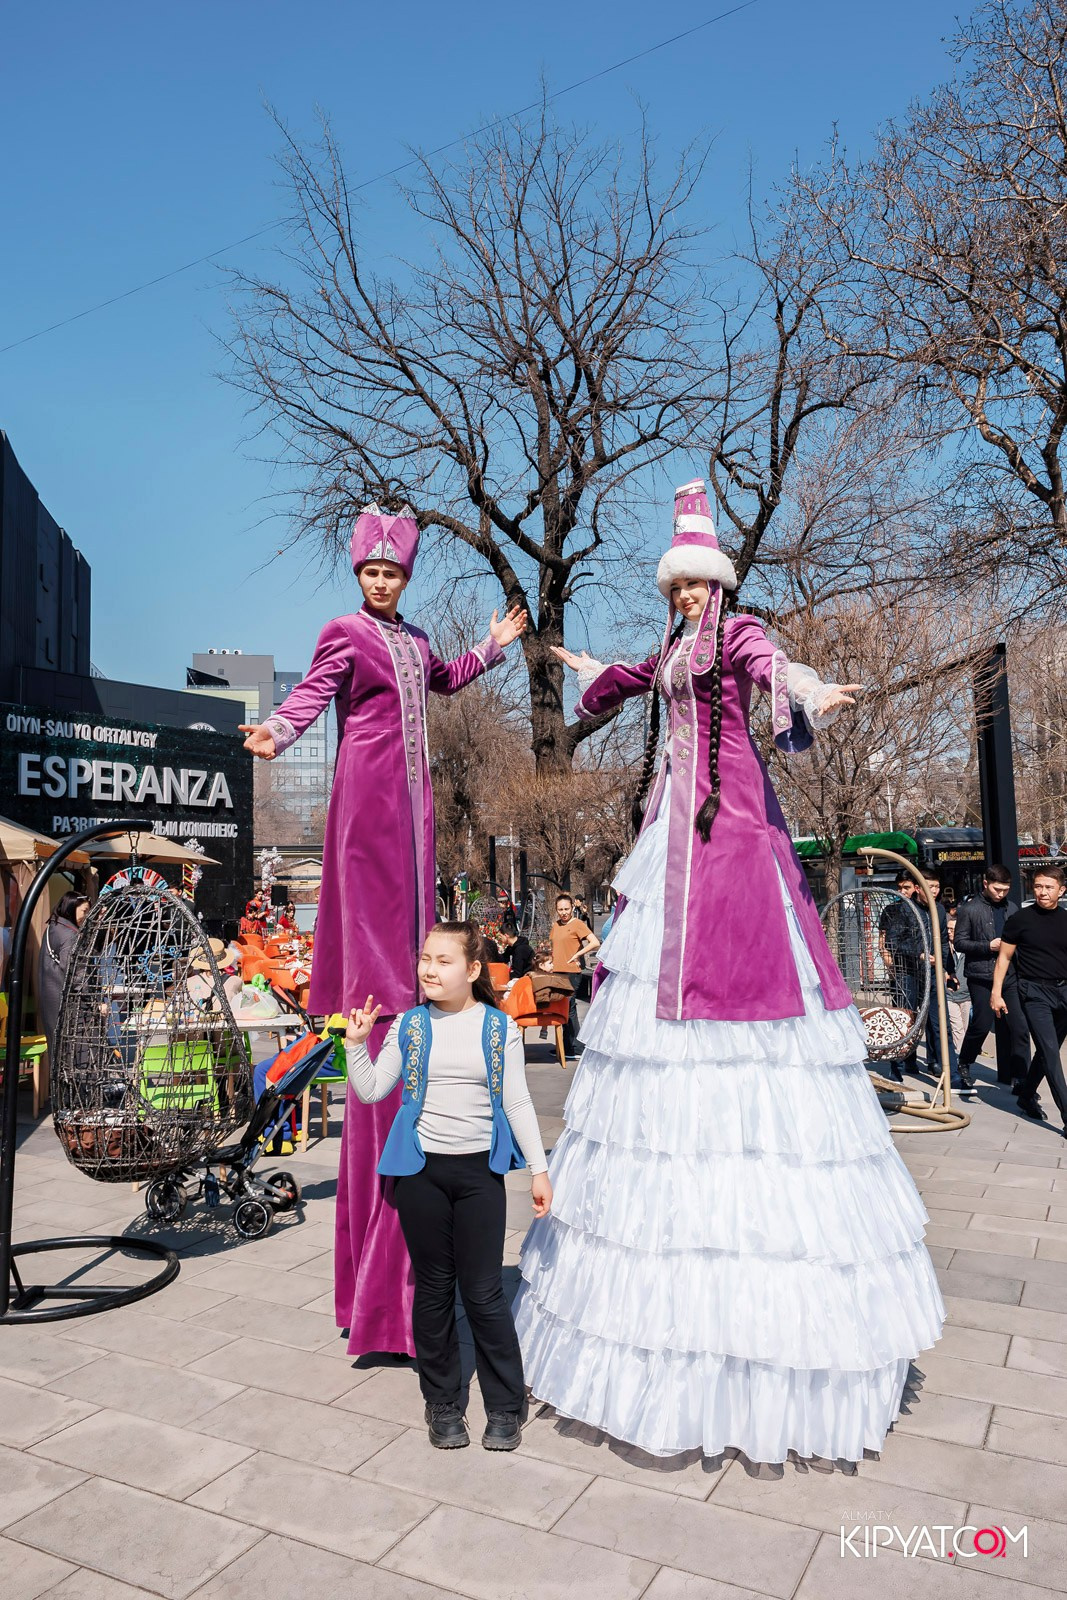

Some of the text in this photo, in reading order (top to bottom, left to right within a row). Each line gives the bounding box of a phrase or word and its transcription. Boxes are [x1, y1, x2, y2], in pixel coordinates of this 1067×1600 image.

[93, 725, 158, 749] ORTALYGY
[18, 752, 234, 809] ESPERANZA
[179, 821, 238, 838] КОМПЛЕКС
